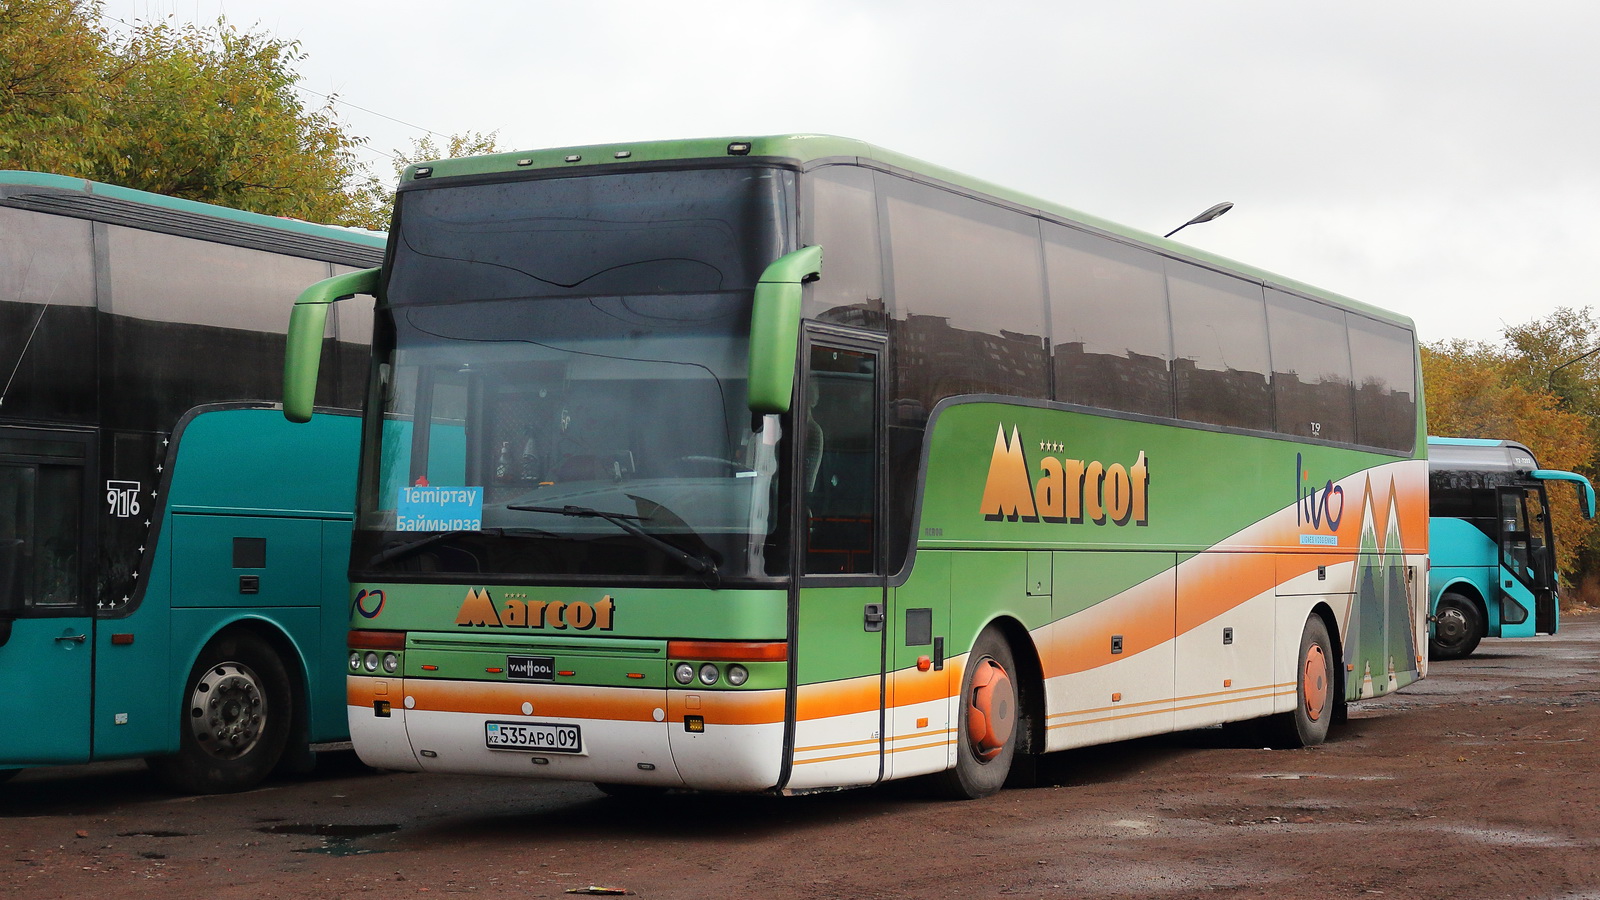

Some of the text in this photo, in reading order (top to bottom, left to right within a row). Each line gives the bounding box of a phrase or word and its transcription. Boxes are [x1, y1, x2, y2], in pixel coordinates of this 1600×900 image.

[1310, 422, 1321, 432] T9
[979, 421, 1150, 526] Marcot
[396, 514, 481, 531] Баймырза
[454, 586, 616, 631] Marcot
[488, 735, 499, 743] KZ
